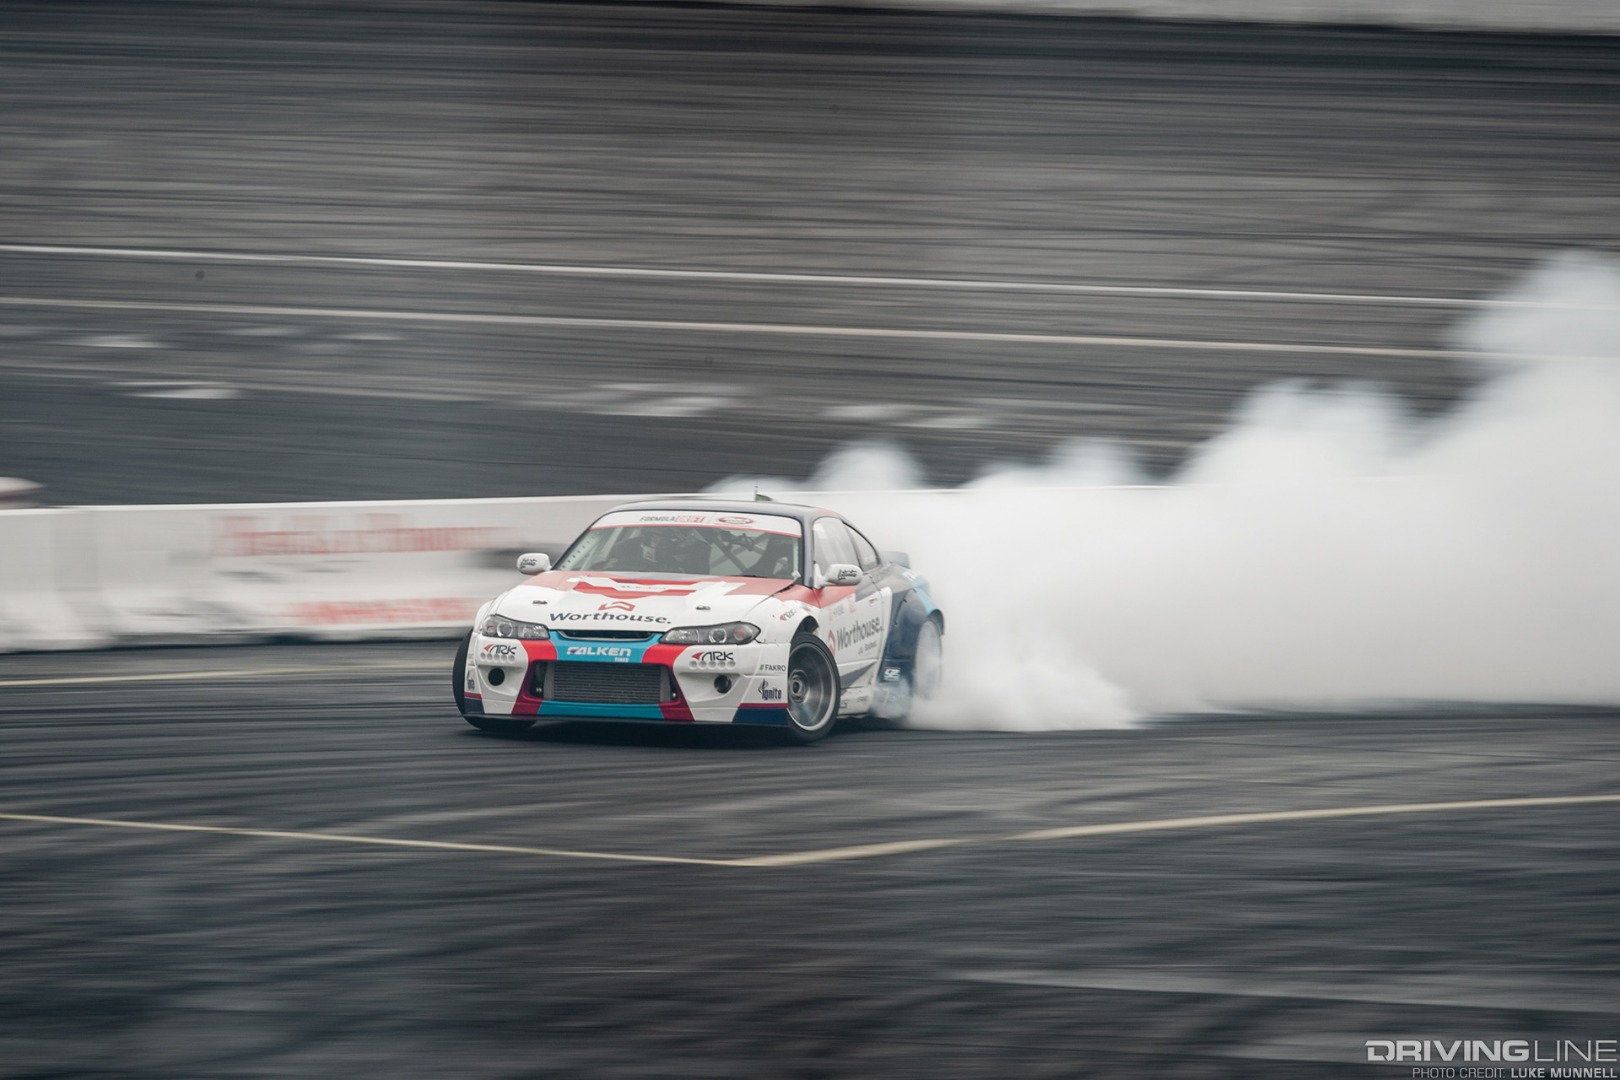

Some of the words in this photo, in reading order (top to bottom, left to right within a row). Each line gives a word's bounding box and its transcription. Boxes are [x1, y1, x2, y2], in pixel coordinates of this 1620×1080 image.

[550, 611, 672, 624] Worthouse.
[487, 644, 518, 656] ARK
[566, 646, 632, 657] FALKEN
[699, 651, 735, 662] ARK
[764, 664, 787, 672] FAKRO
